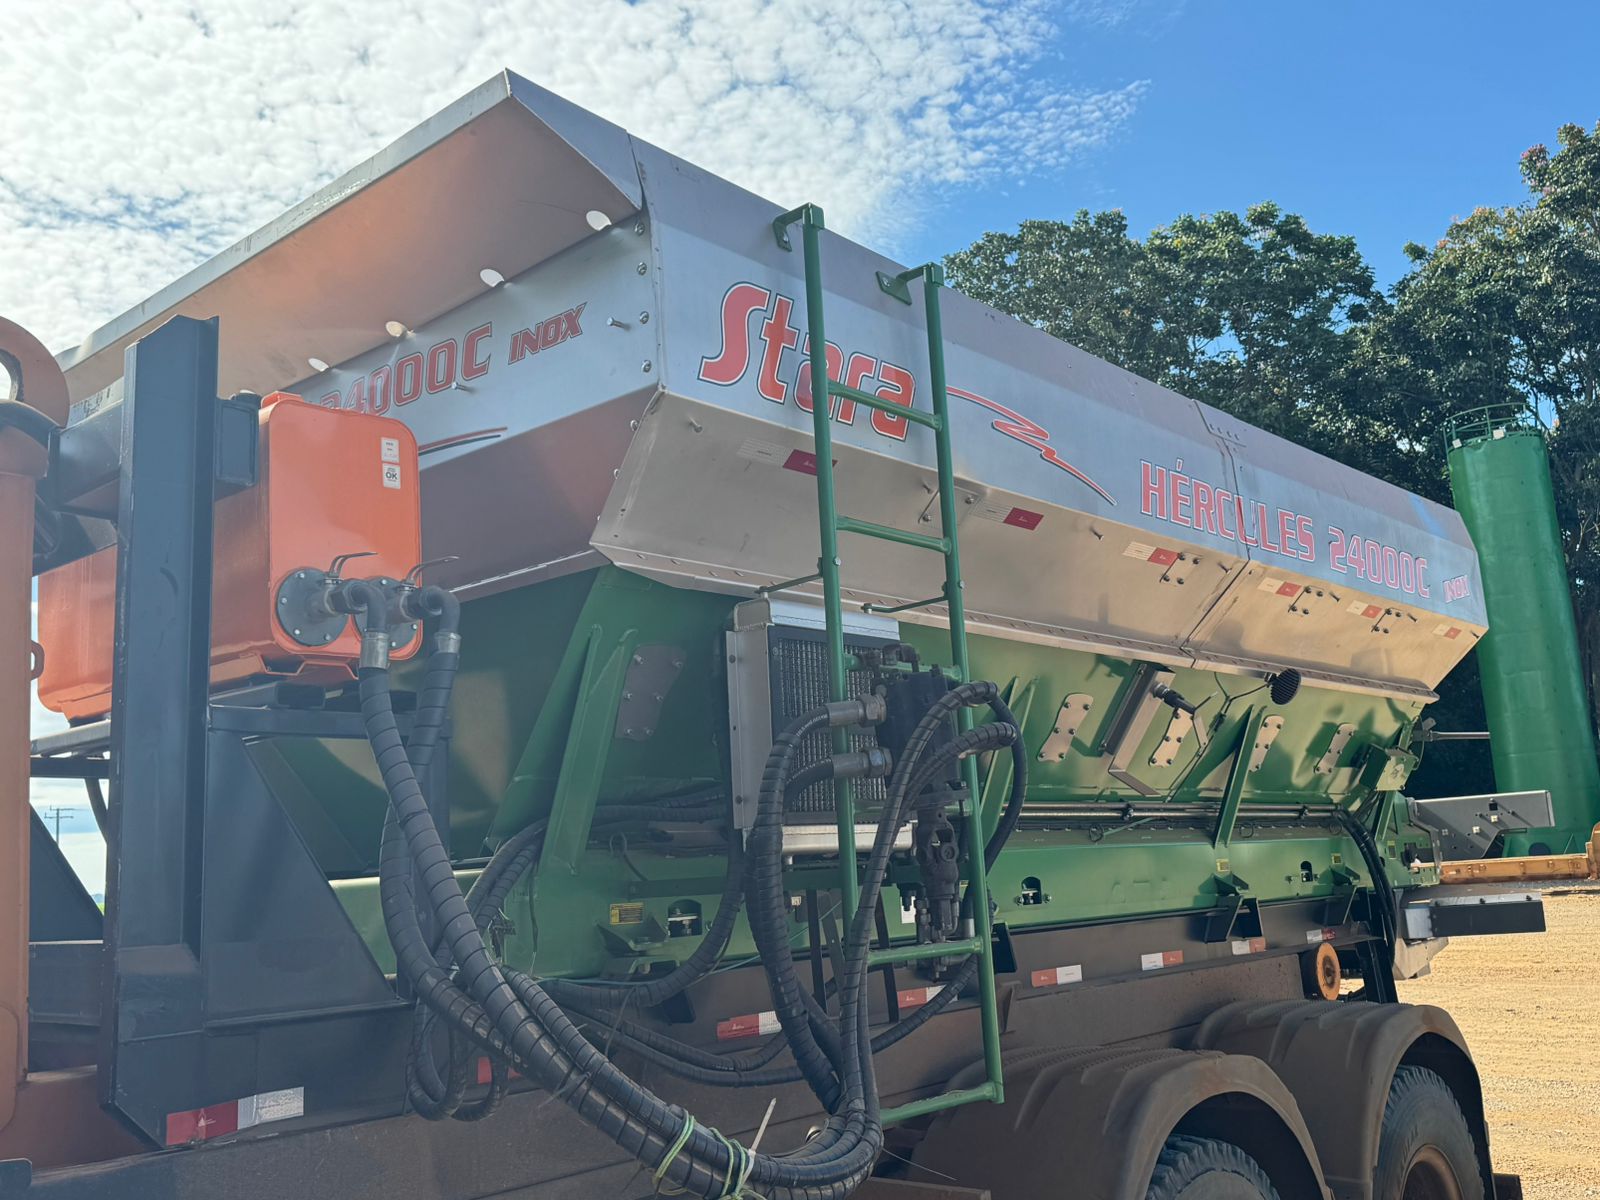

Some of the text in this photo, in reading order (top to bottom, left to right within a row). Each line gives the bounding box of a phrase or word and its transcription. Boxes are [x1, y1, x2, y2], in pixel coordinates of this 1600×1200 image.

[508, 302, 588, 365] INOX
[697, 281, 915, 442] Stara
[385, 471, 398, 480] OK
[1140, 457, 1471, 604] HÉRCULES 24000C INOX
